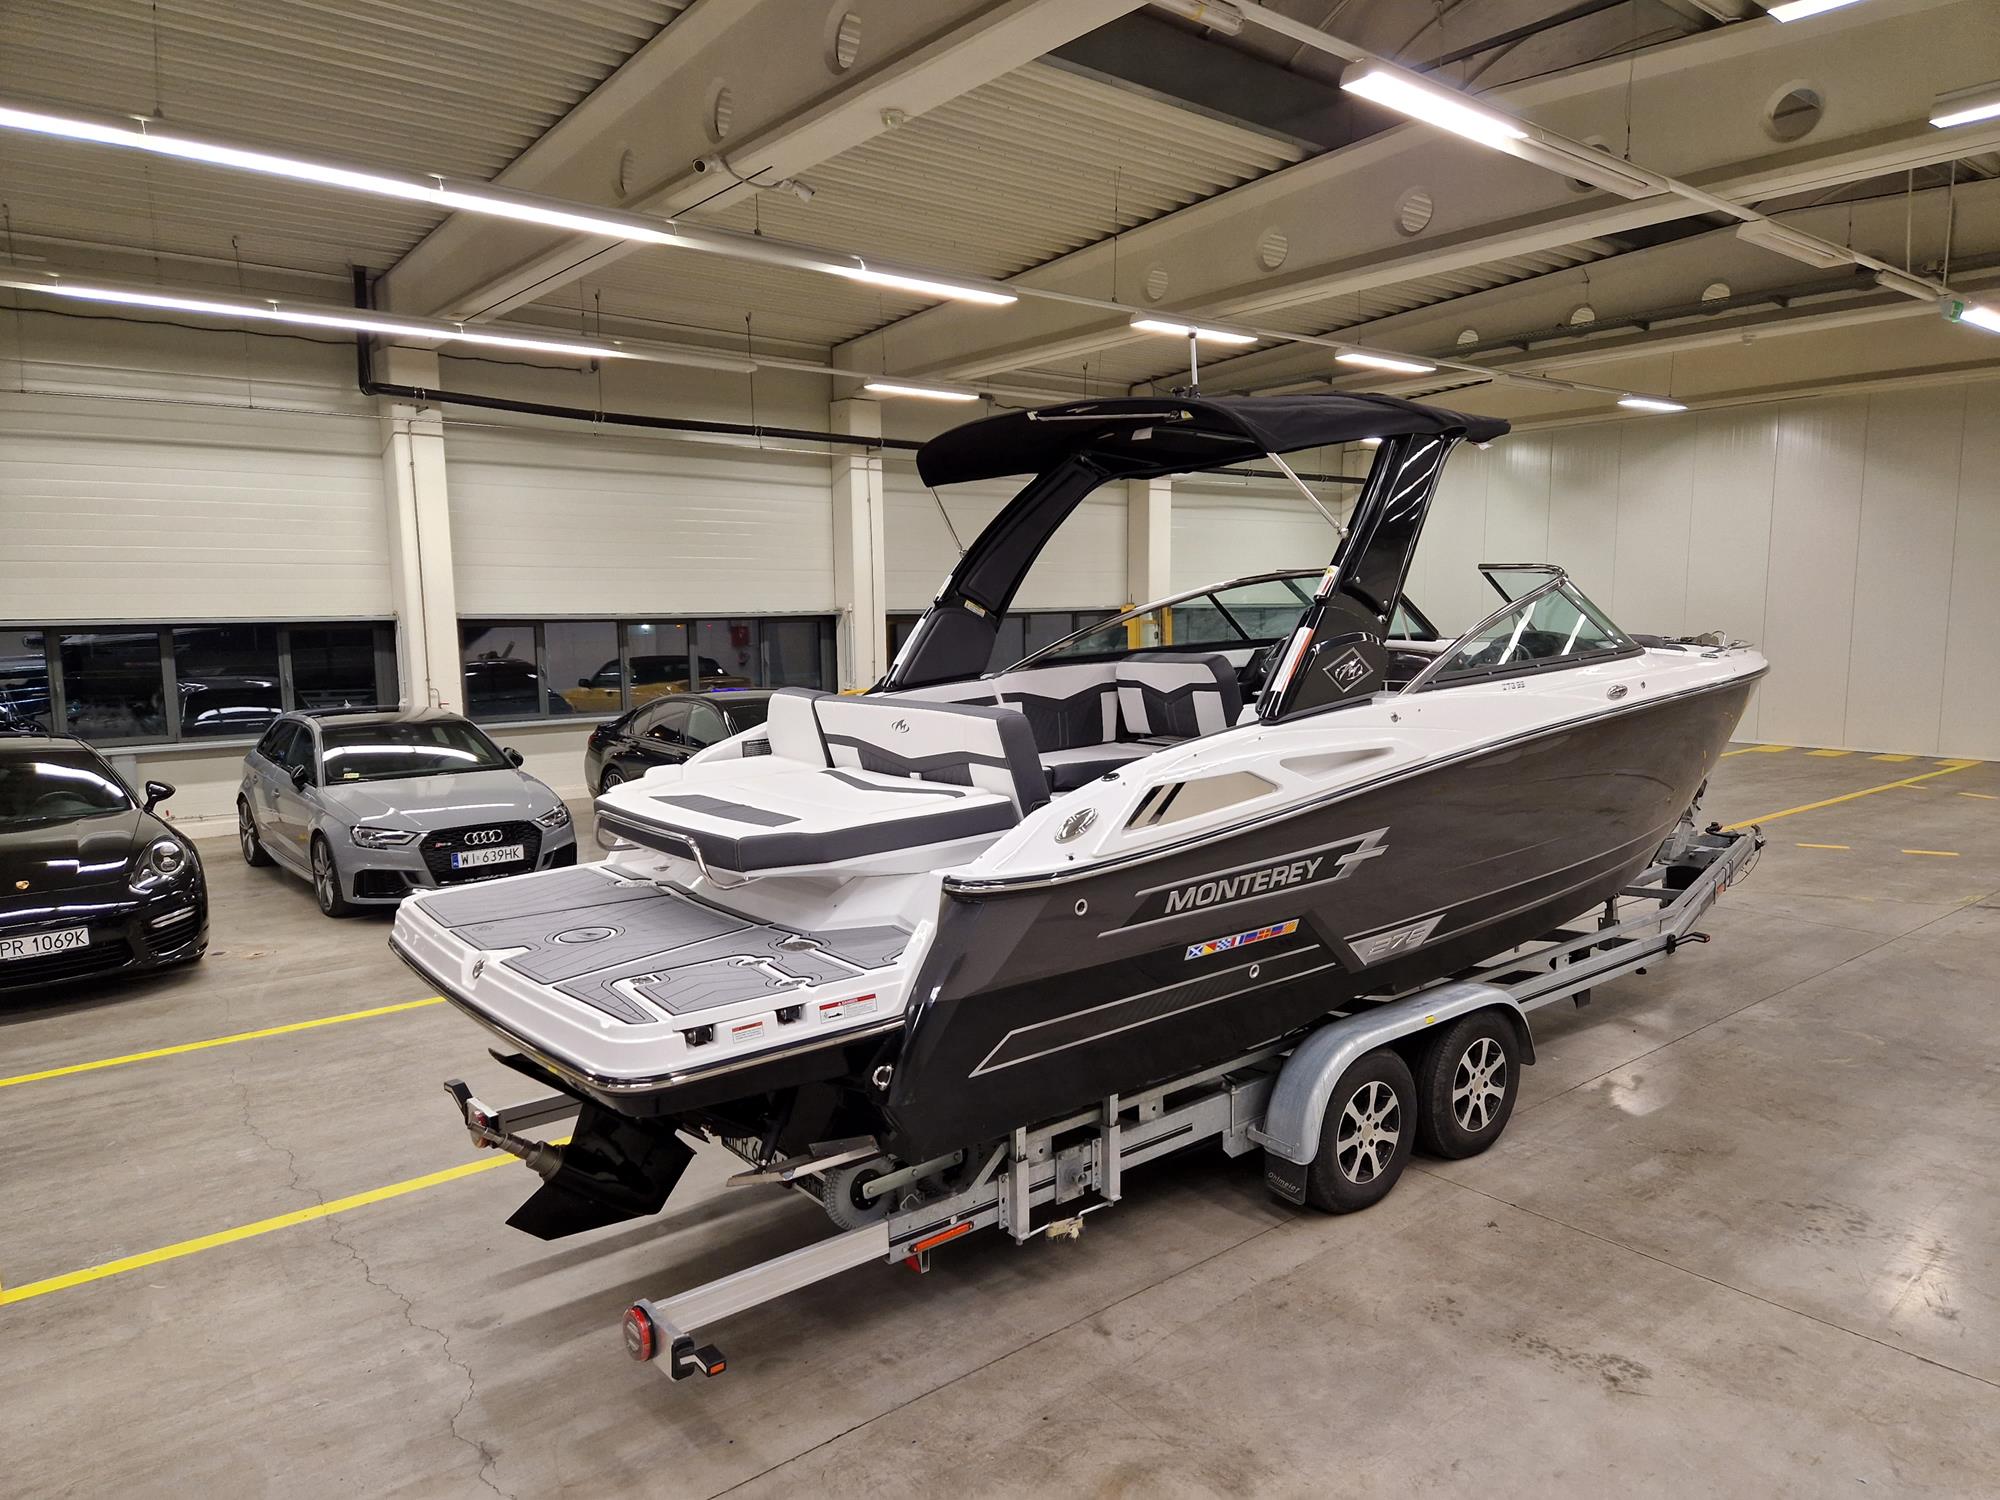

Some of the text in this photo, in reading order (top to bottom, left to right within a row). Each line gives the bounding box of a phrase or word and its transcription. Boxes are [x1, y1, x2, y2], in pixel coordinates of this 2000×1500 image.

[482, 847, 521, 863] 639HK
[1164, 856, 1324, 914] MONTEREY
[32, 929, 86, 952] 1069K
